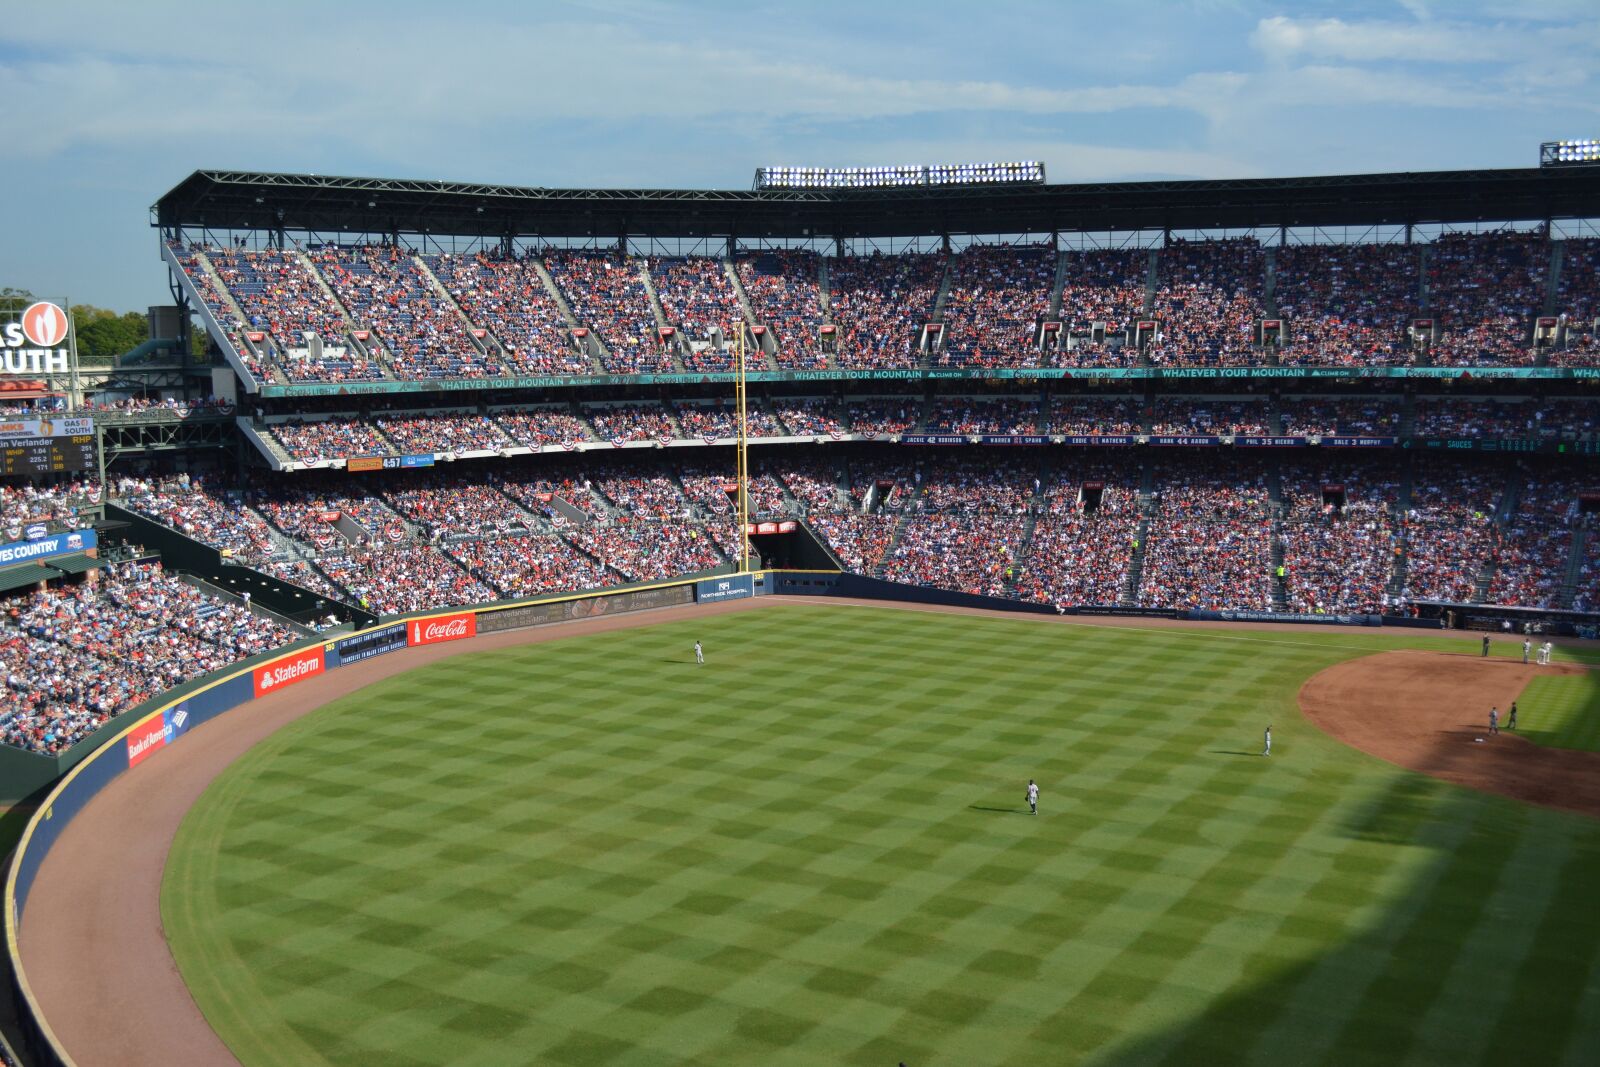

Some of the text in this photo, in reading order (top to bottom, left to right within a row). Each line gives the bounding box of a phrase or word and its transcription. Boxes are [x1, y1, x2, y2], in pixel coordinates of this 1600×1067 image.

[0, 323, 24, 347] S
[0, 349, 68, 374] UTH
[794, 370, 922, 380] WHATEVER YOUR MOUNTAIN
[1162, 369, 1305, 377] WHATEVER YOUR MOUNTAIN
[438, 377, 564, 390] WHATEVER YOUR MOUNTAIN
[64, 427, 91, 435] SOUTH
[11, 438, 53, 447] Verlander
[72, 435, 92, 444] RHP
[927, 436, 936, 444] 42
[1177, 436, 1188, 444] 44
[1447, 440, 1472, 449] SAUCES
[383, 457, 401, 468] 4:57
[14, 540, 59, 559] COUNTRY
[425, 618, 469, 639] Coca-Cola
[129, 739, 143, 760] Bank
[149, 724, 173, 747] America
